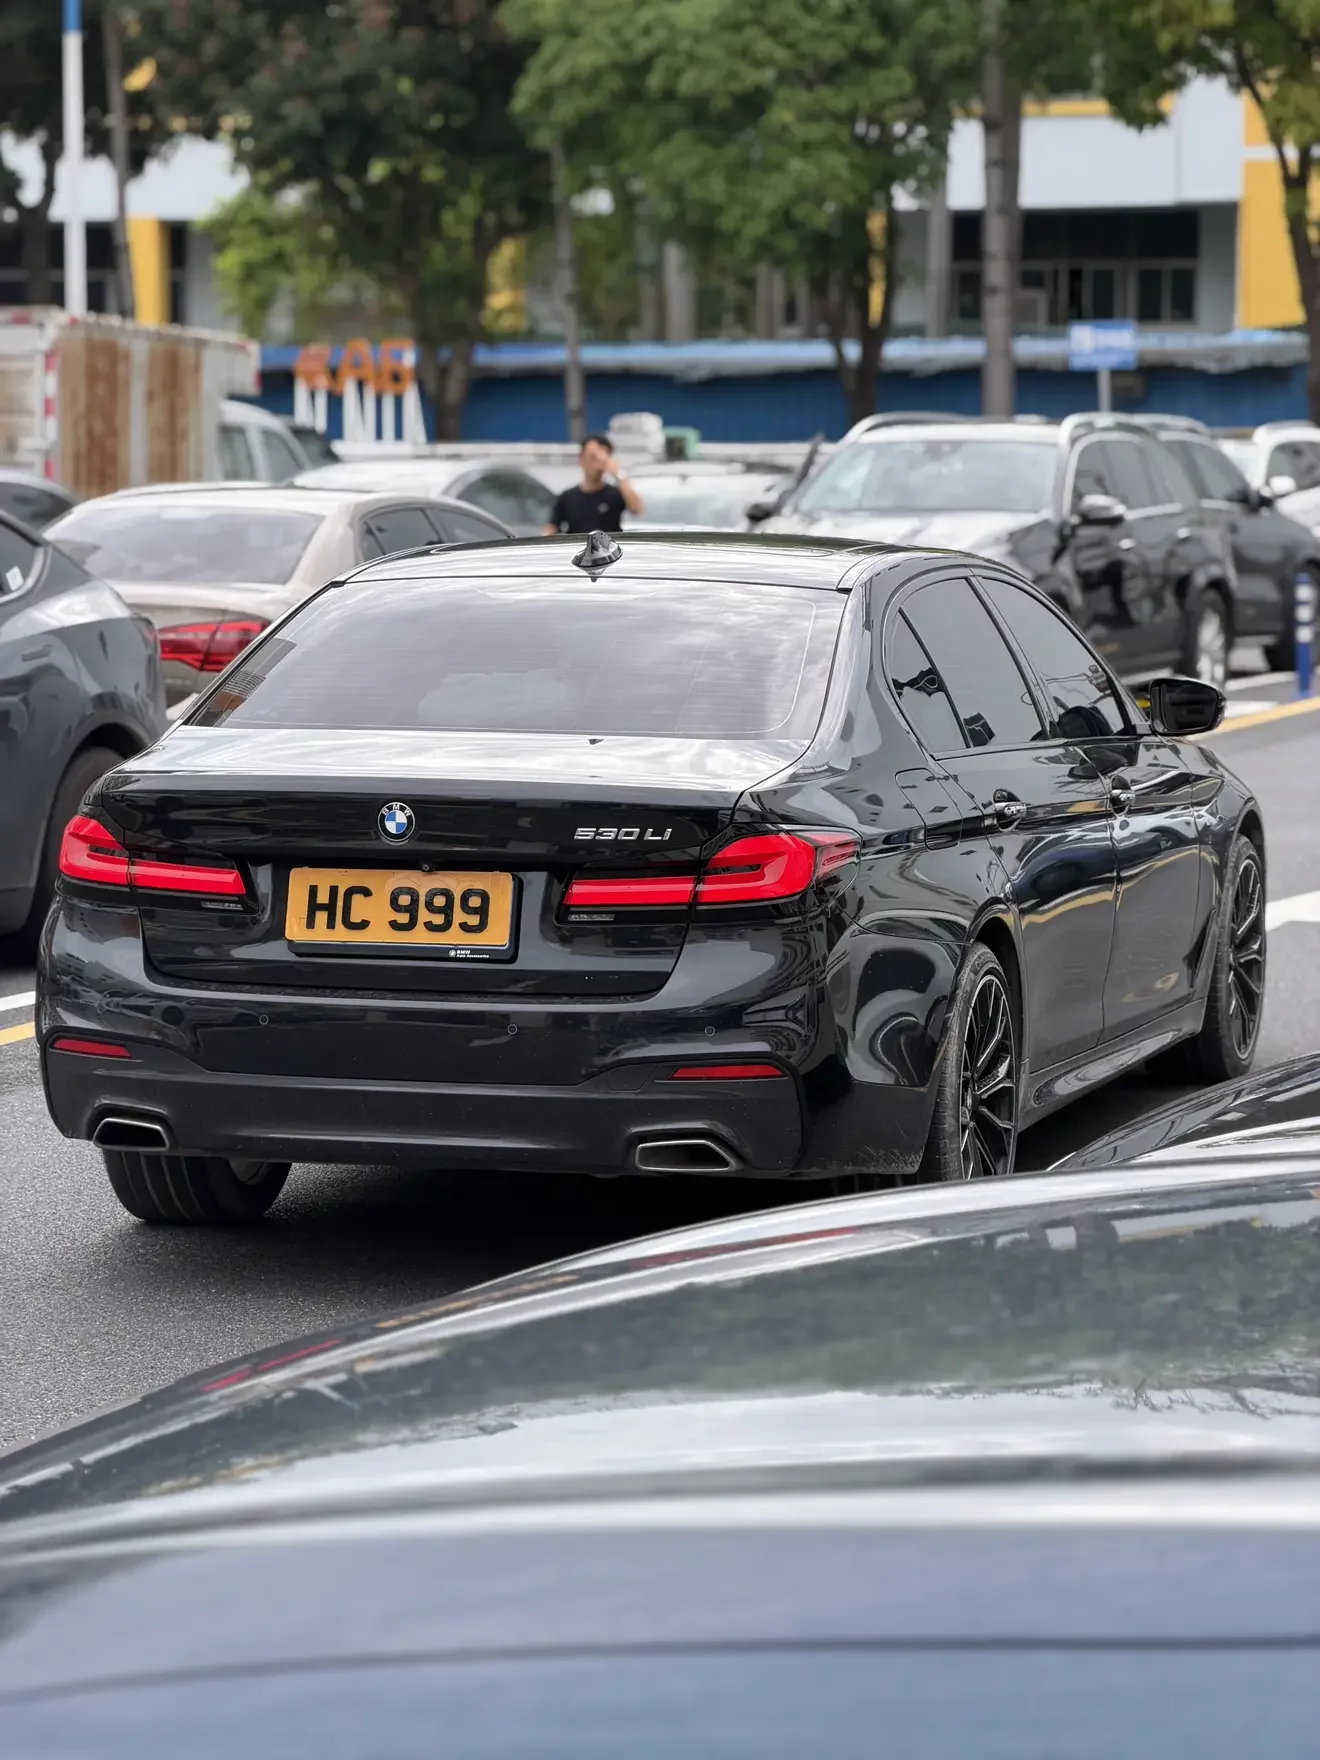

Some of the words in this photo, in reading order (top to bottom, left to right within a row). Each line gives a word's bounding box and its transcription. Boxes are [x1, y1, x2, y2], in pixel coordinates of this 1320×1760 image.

[381, 803, 412, 816] BMW
[305, 884, 374, 931] HC
[388, 886, 490, 933] 999
